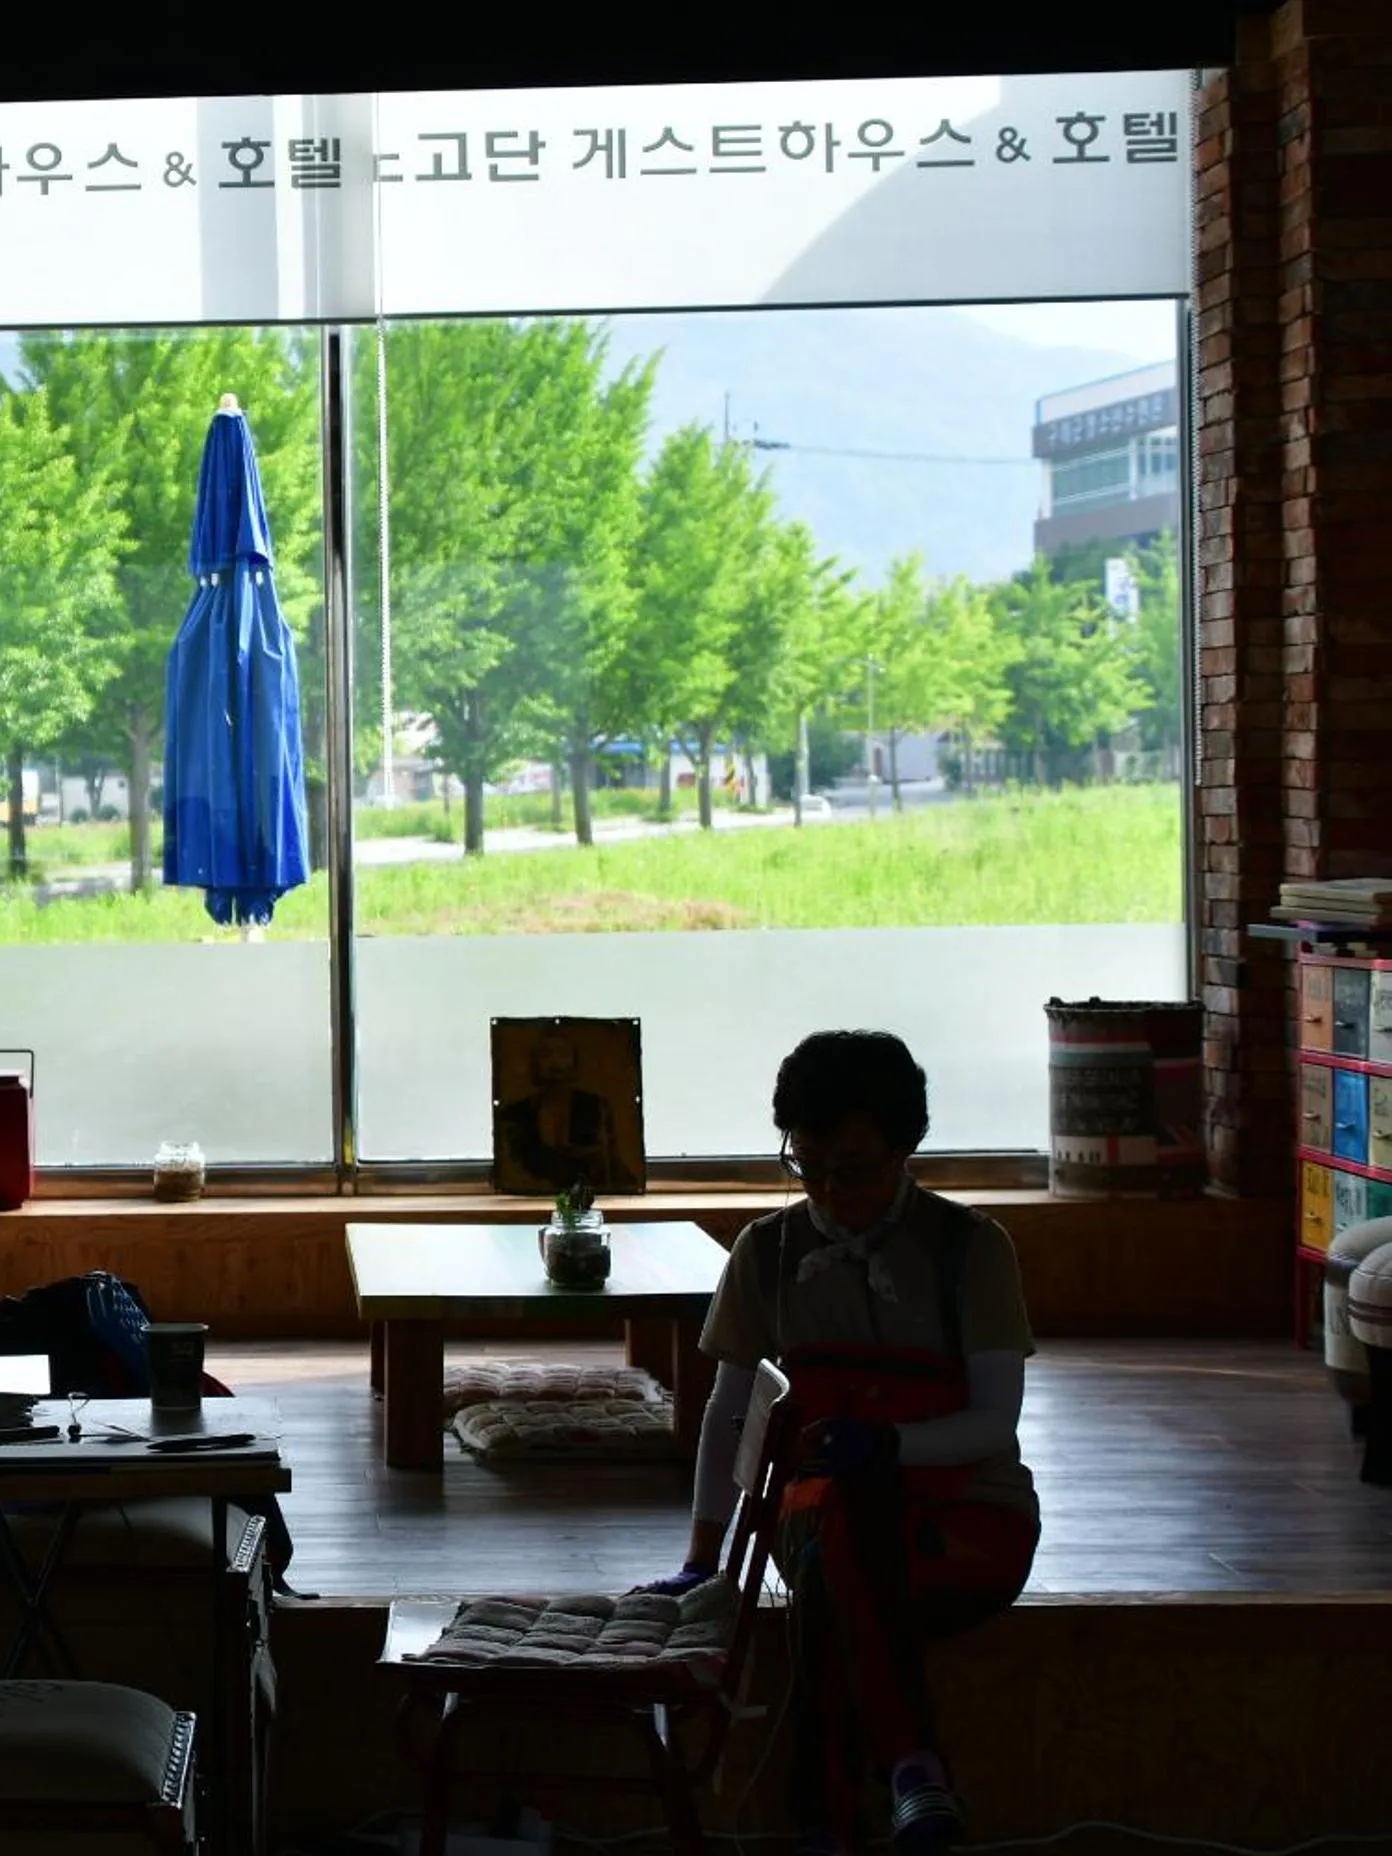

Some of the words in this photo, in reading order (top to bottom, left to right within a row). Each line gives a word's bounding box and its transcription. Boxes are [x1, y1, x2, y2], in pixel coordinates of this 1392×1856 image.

[163, 152, 197, 188] &
[218, 137, 341, 189] 호텔
[572, 118, 975, 179] 게스트하우스
[996, 126, 1032, 164] &
[1052, 112, 1178, 165] 호텔
